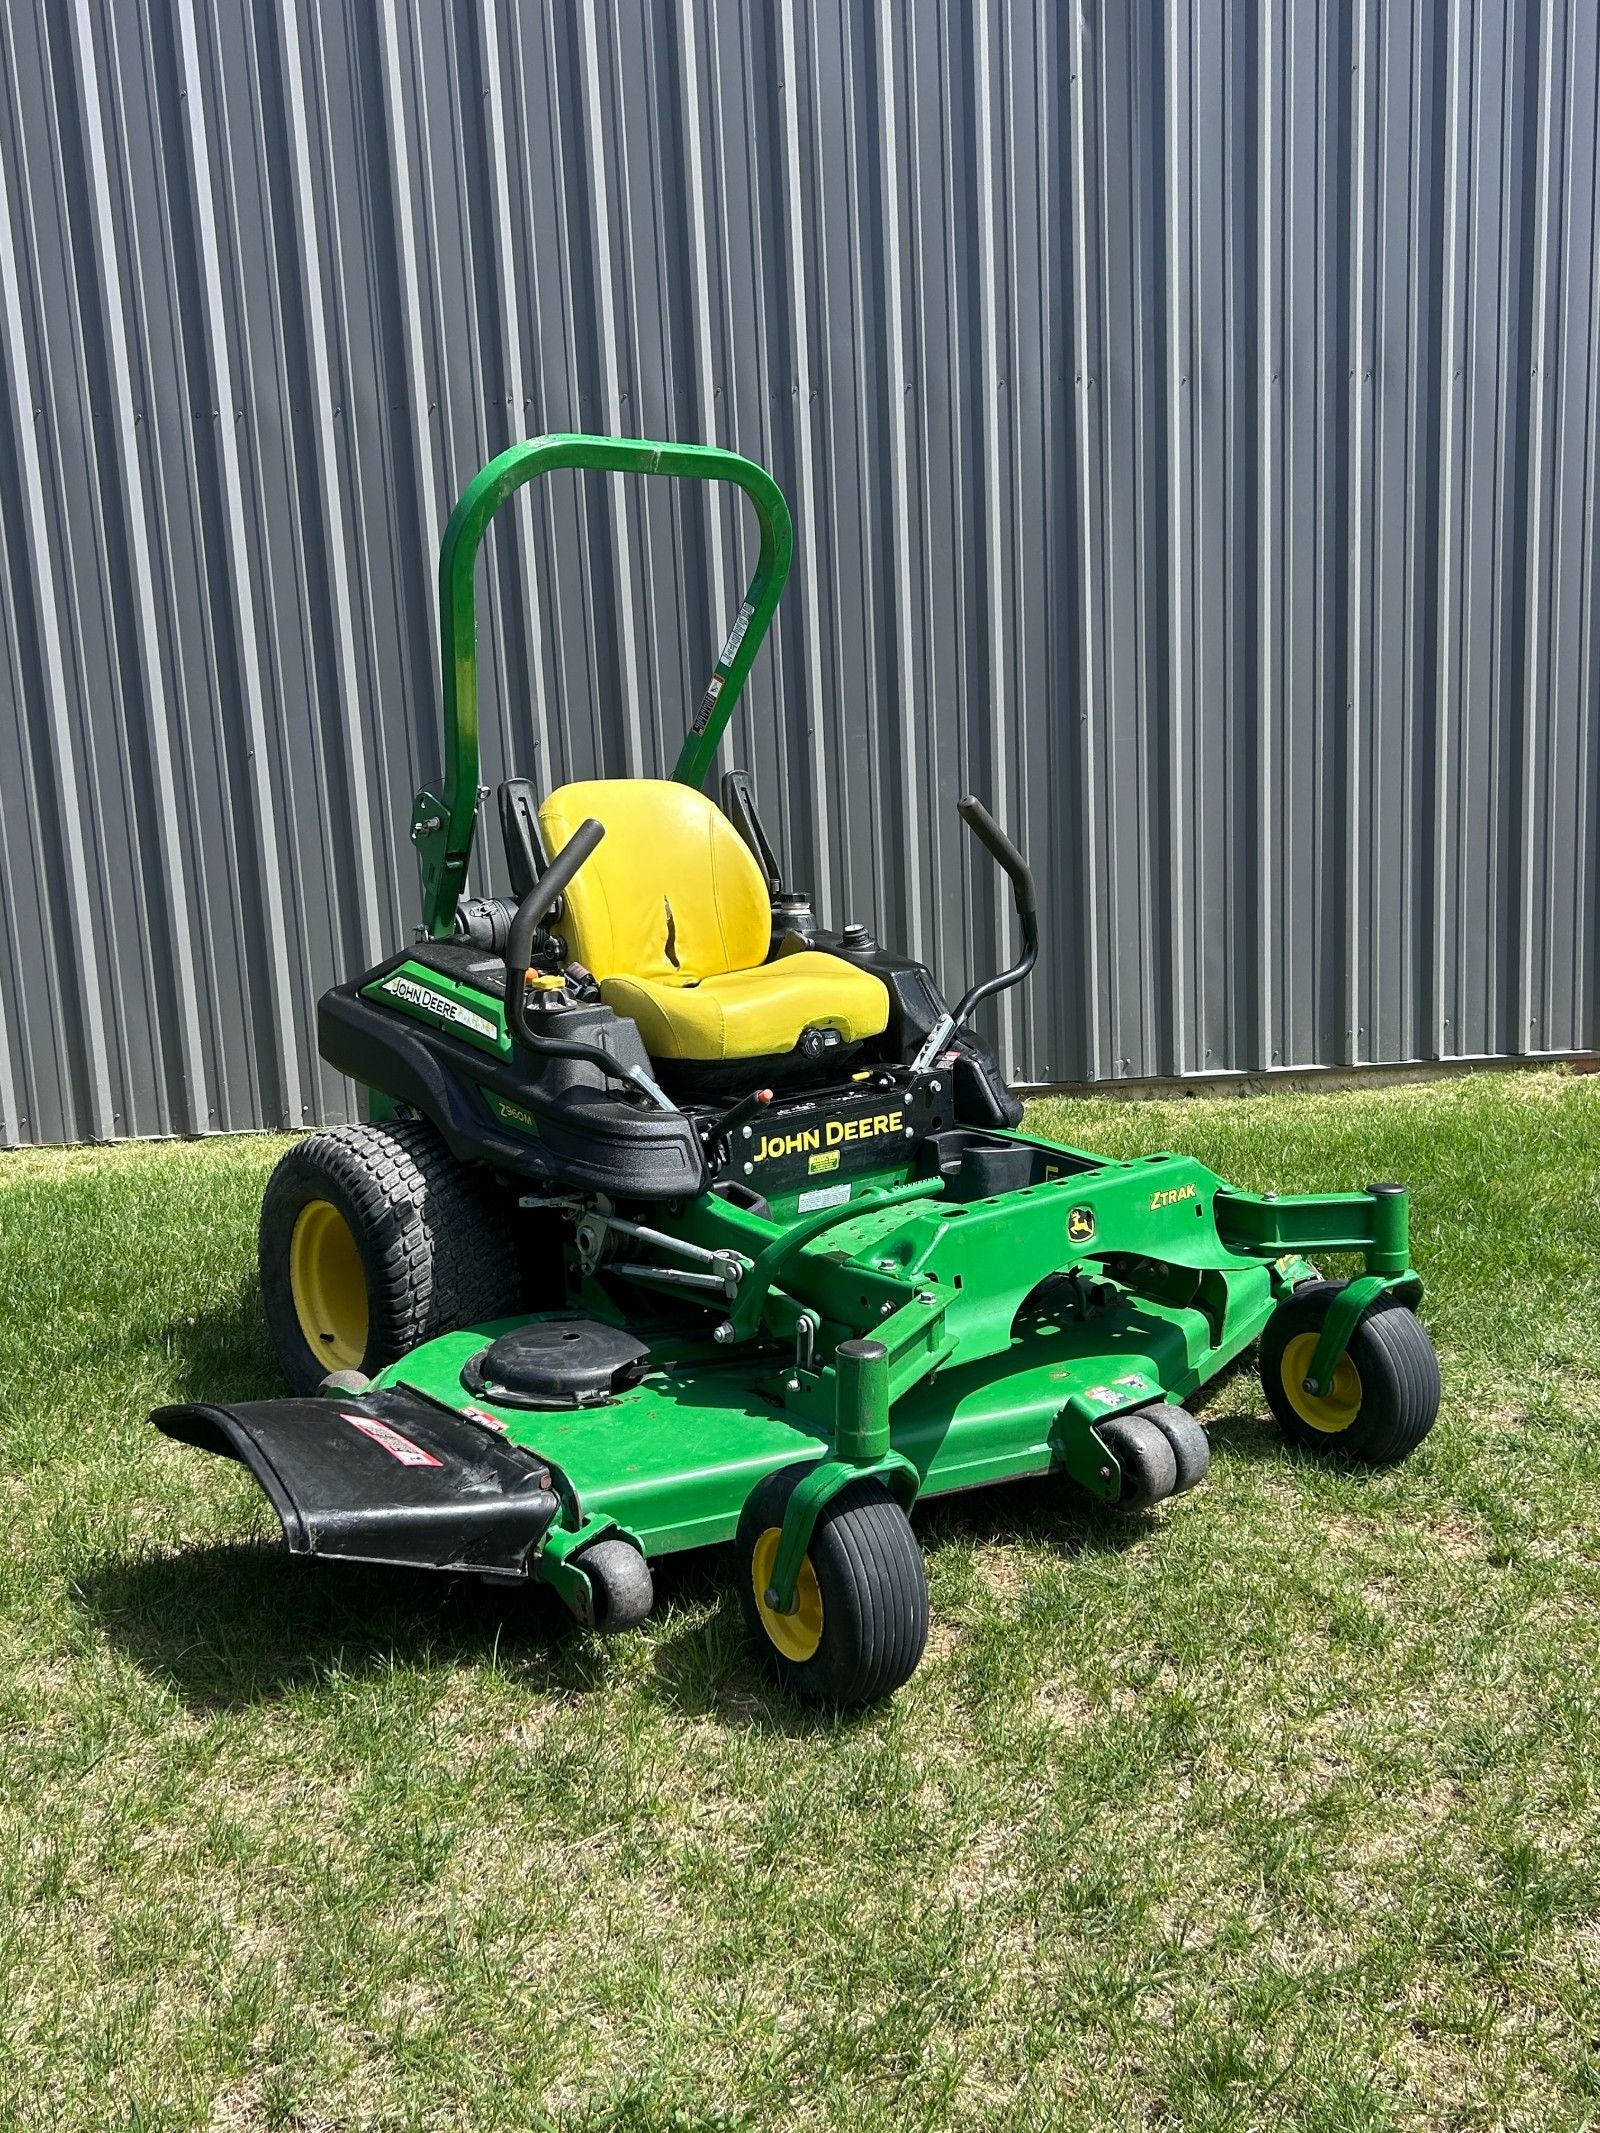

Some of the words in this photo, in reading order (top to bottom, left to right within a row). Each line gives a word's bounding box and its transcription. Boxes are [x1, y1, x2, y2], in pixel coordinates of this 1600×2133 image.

[392, 980, 421, 1004] JOHN
[422, 991, 457, 1019] DEERE
[754, 1129, 820, 1162] JOHN
[825, 1111, 903, 1146] DEERE
[1150, 1183, 1197, 1211] ZTRAK
